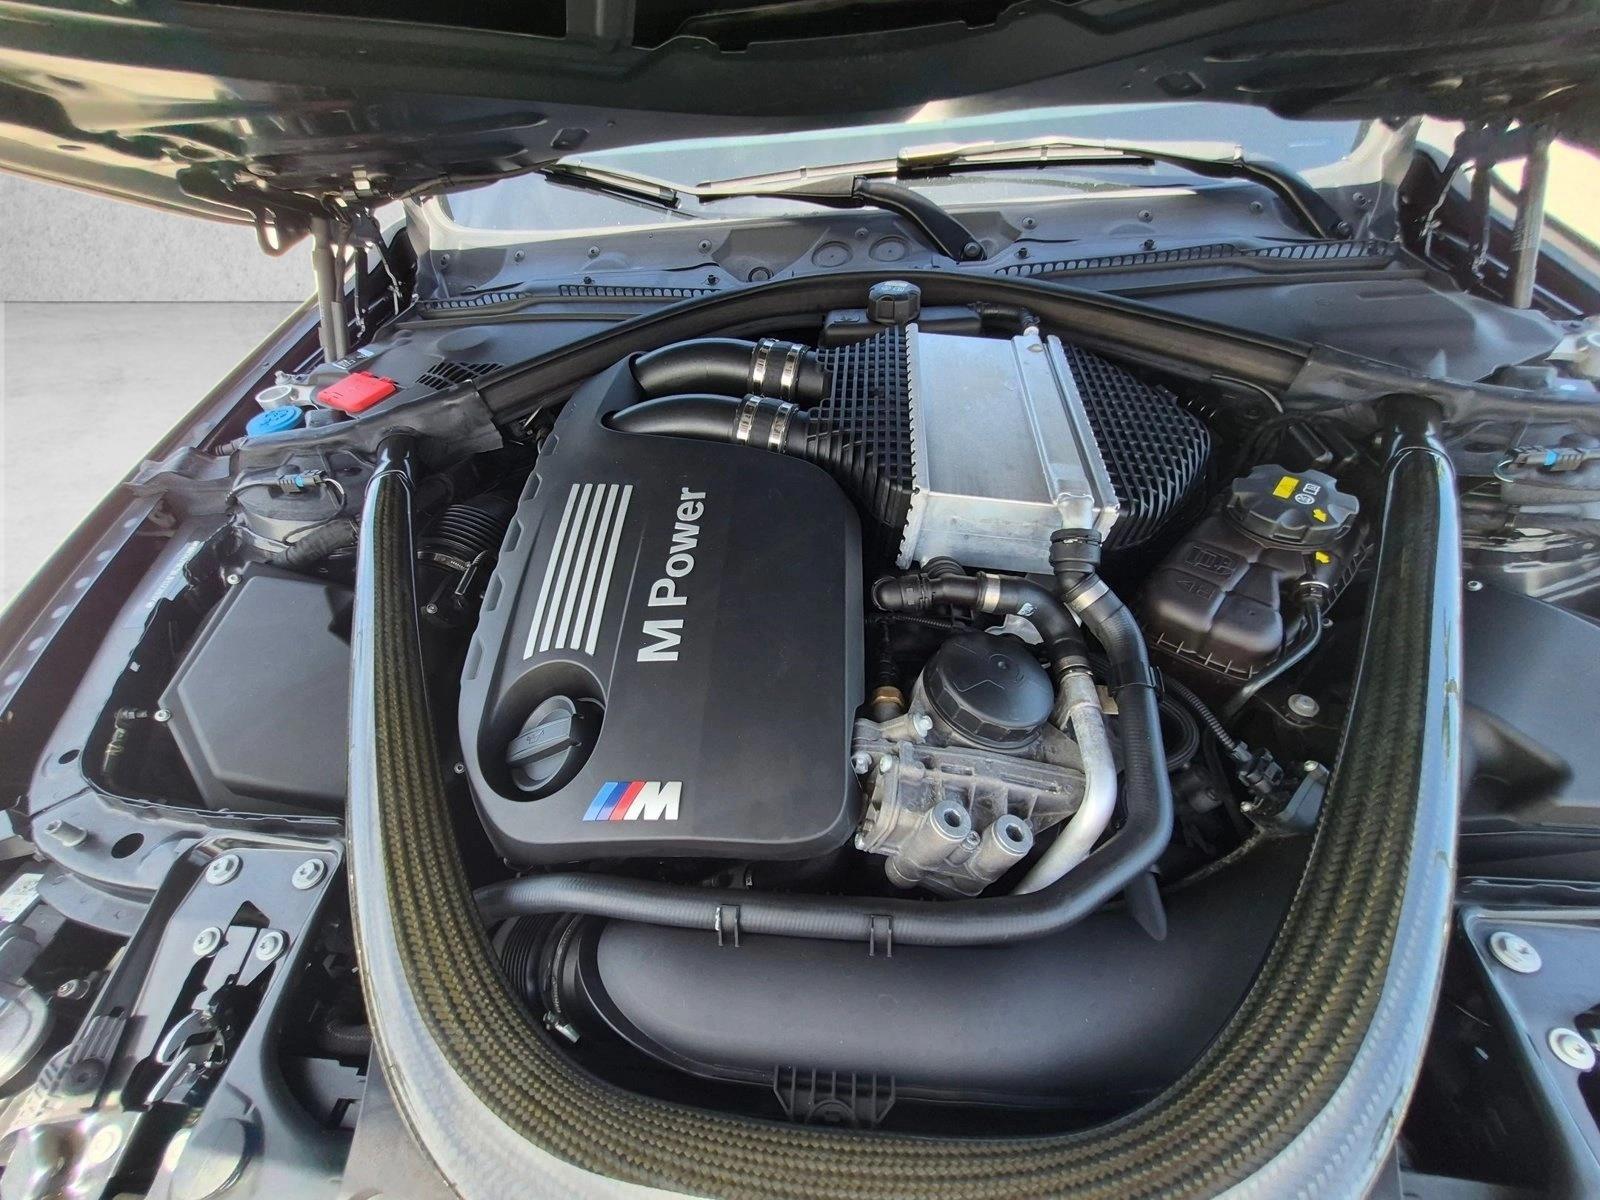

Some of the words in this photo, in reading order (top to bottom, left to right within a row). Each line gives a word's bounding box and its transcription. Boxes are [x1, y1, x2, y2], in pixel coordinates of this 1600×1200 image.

[648, 487, 706, 607] Power
[637, 619, 684, 662] M
[622, 781, 683, 821] M
